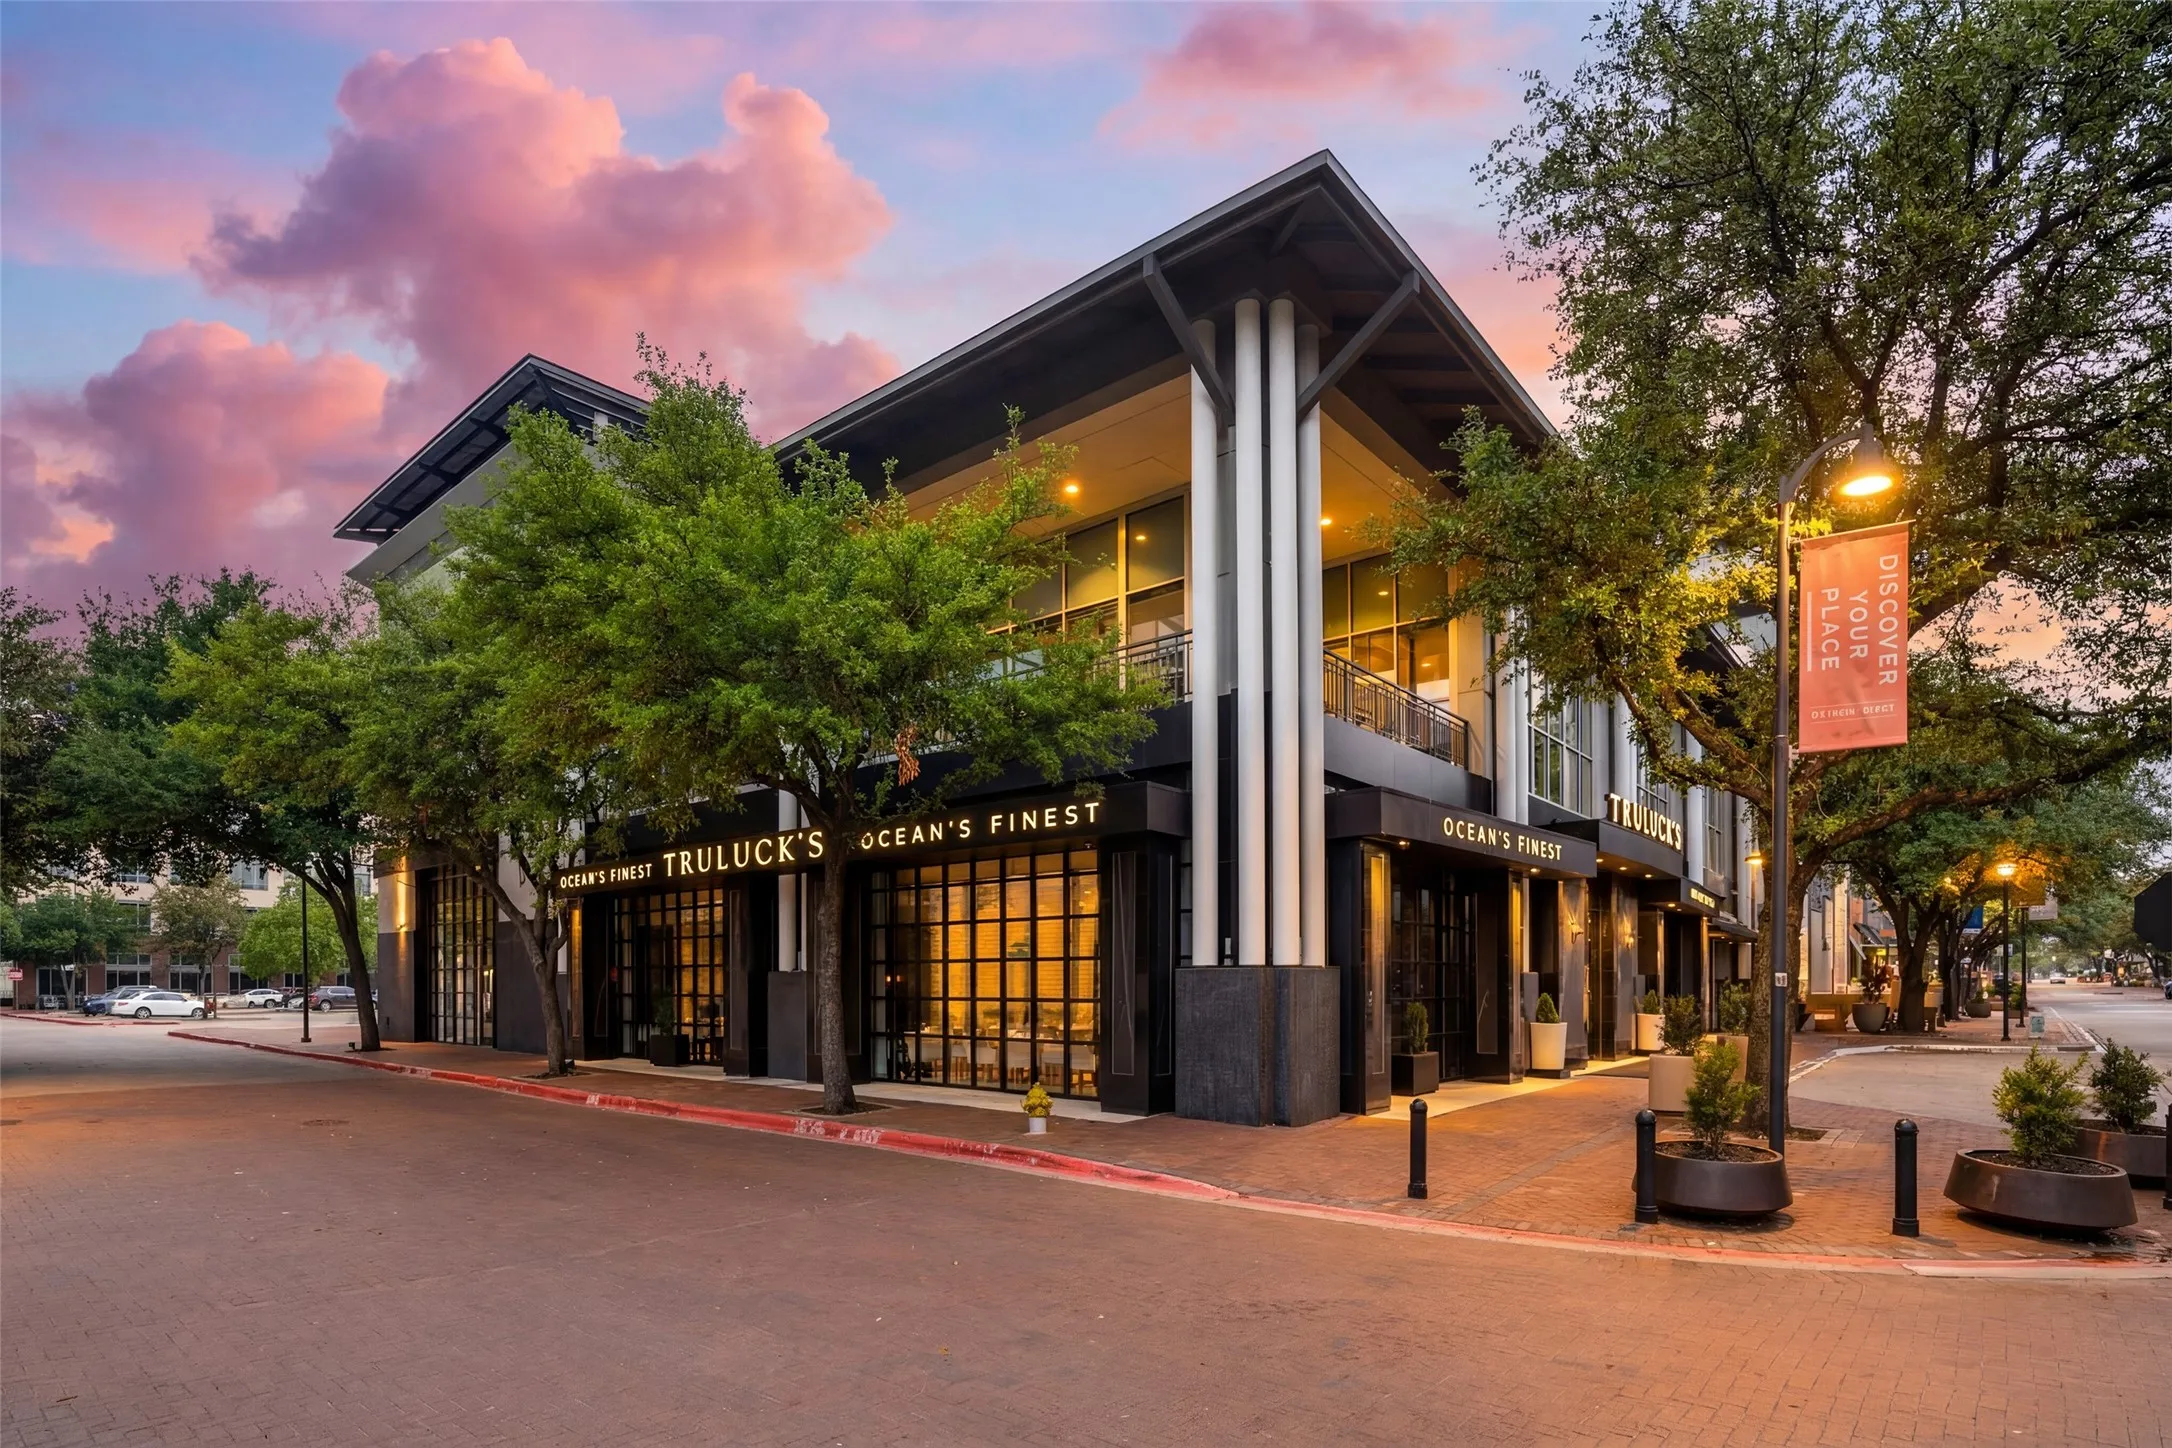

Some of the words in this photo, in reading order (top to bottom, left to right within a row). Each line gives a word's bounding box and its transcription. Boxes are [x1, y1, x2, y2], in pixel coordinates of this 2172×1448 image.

[1821, 587, 1840, 671] PLACE
[1849, 589, 1869, 659] YOUR
[1878, 554, 1899, 686] DISCOVER
[861, 819, 971, 850] OCEAN'S
[991, 802, 1100, 834] FINEST
[1443, 817, 1511, 850] OCEAN'S
[1518, 835, 1562, 861] FINEST
[1608, 793, 1682, 851] TRULUCK'S
[560, 871, 606, 889] OCEAN'S
[611, 863, 652, 882] FINEST
[663, 831, 824, 877] TRULUCK'S
